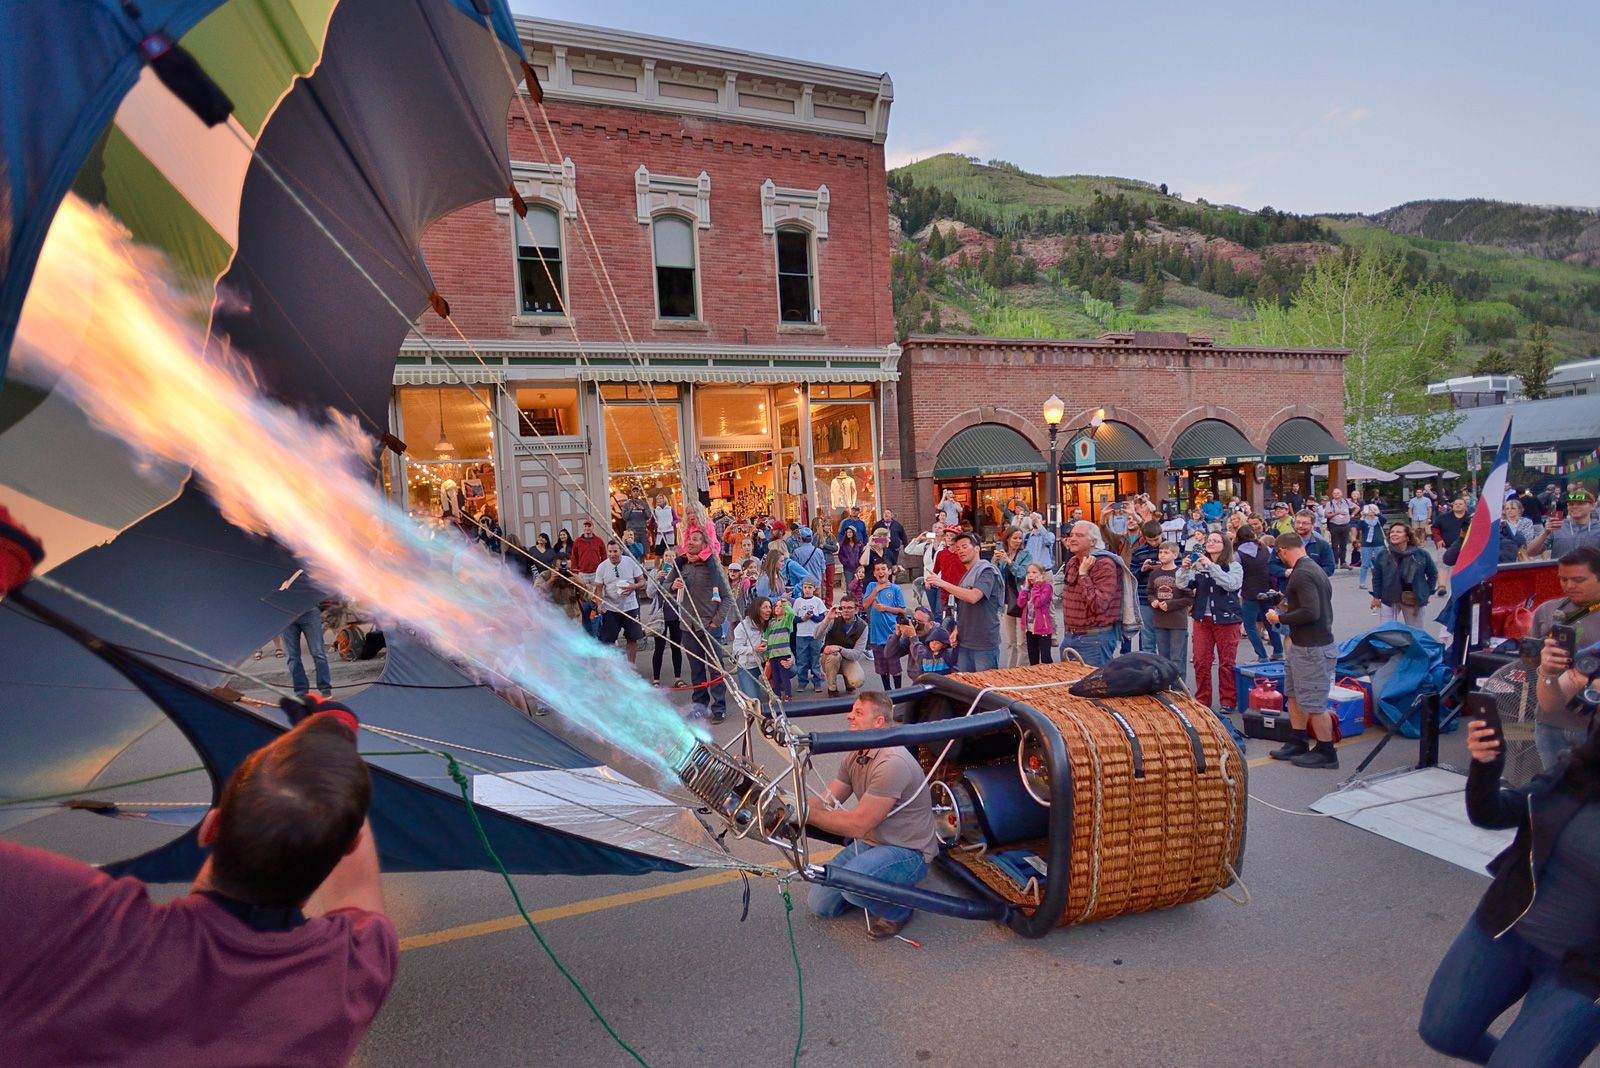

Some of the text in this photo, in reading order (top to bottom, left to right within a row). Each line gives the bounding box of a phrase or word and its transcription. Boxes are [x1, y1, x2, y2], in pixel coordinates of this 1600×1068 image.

[1209, 457, 1227, 465] BEER
[1299, 455, 1319, 463] SODA
[990, 466, 1001, 474] La
